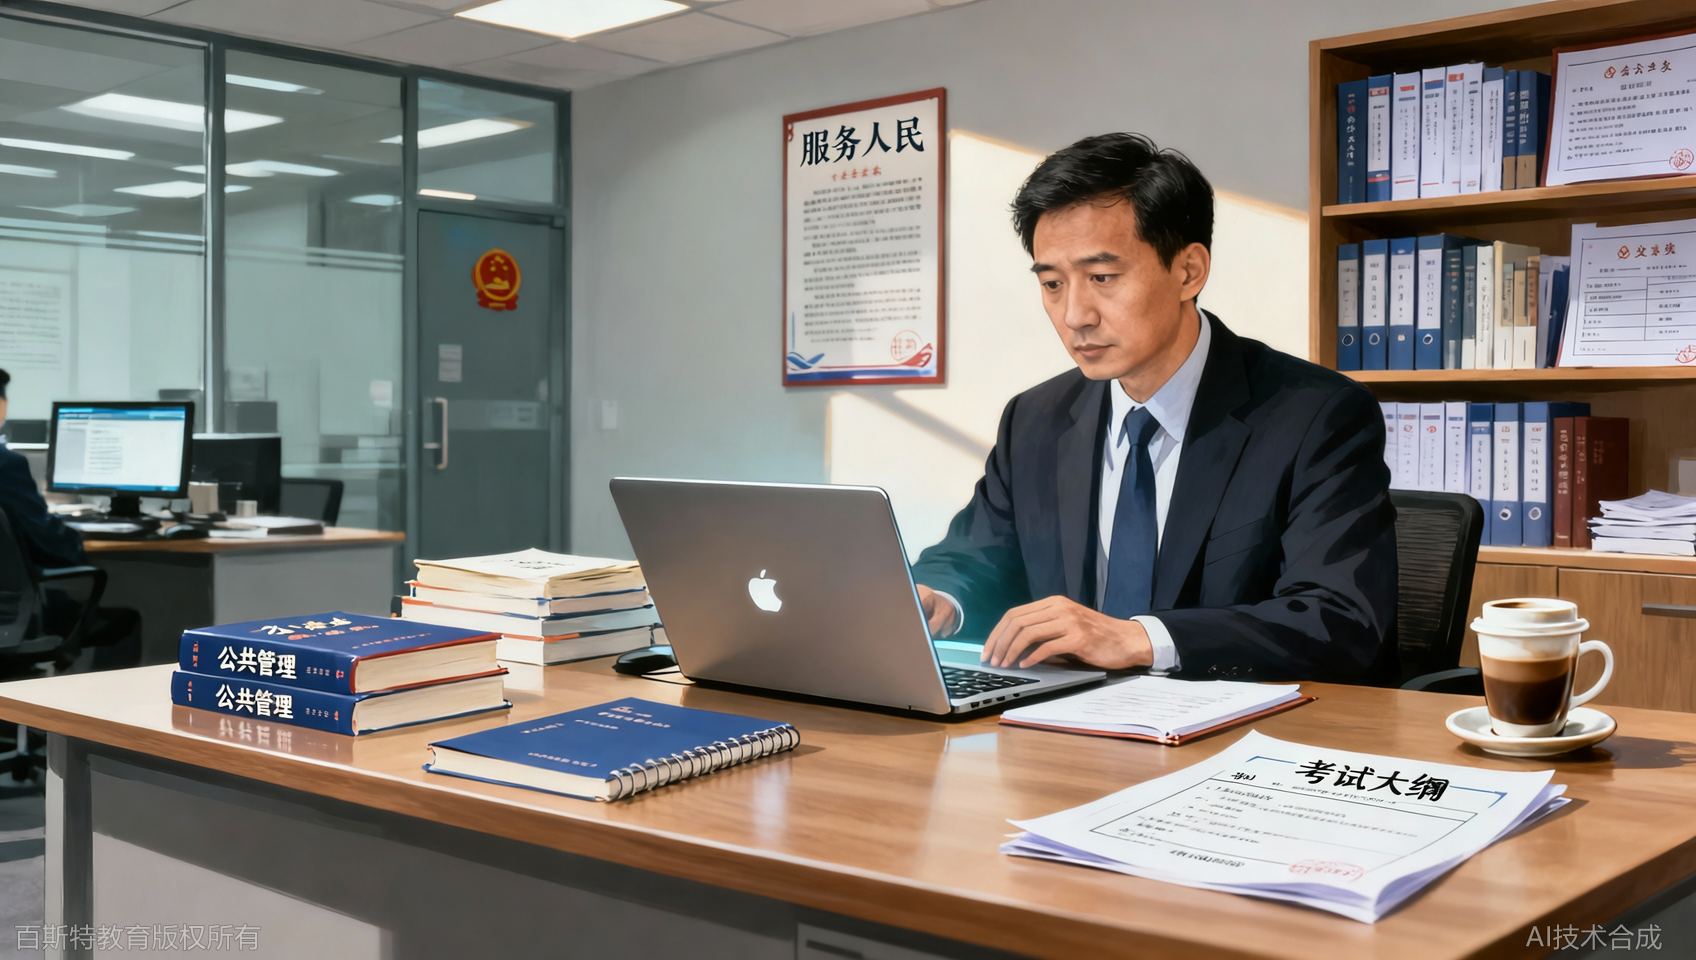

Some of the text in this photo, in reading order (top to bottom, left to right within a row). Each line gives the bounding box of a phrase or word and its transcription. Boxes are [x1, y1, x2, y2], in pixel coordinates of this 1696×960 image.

[800, 116, 925, 168] 服务人民
[217, 645, 298, 680] 公共管理
[215, 684, 294, 719] 公共管理
[1295, 759, 1450, 802] 考试大纲
